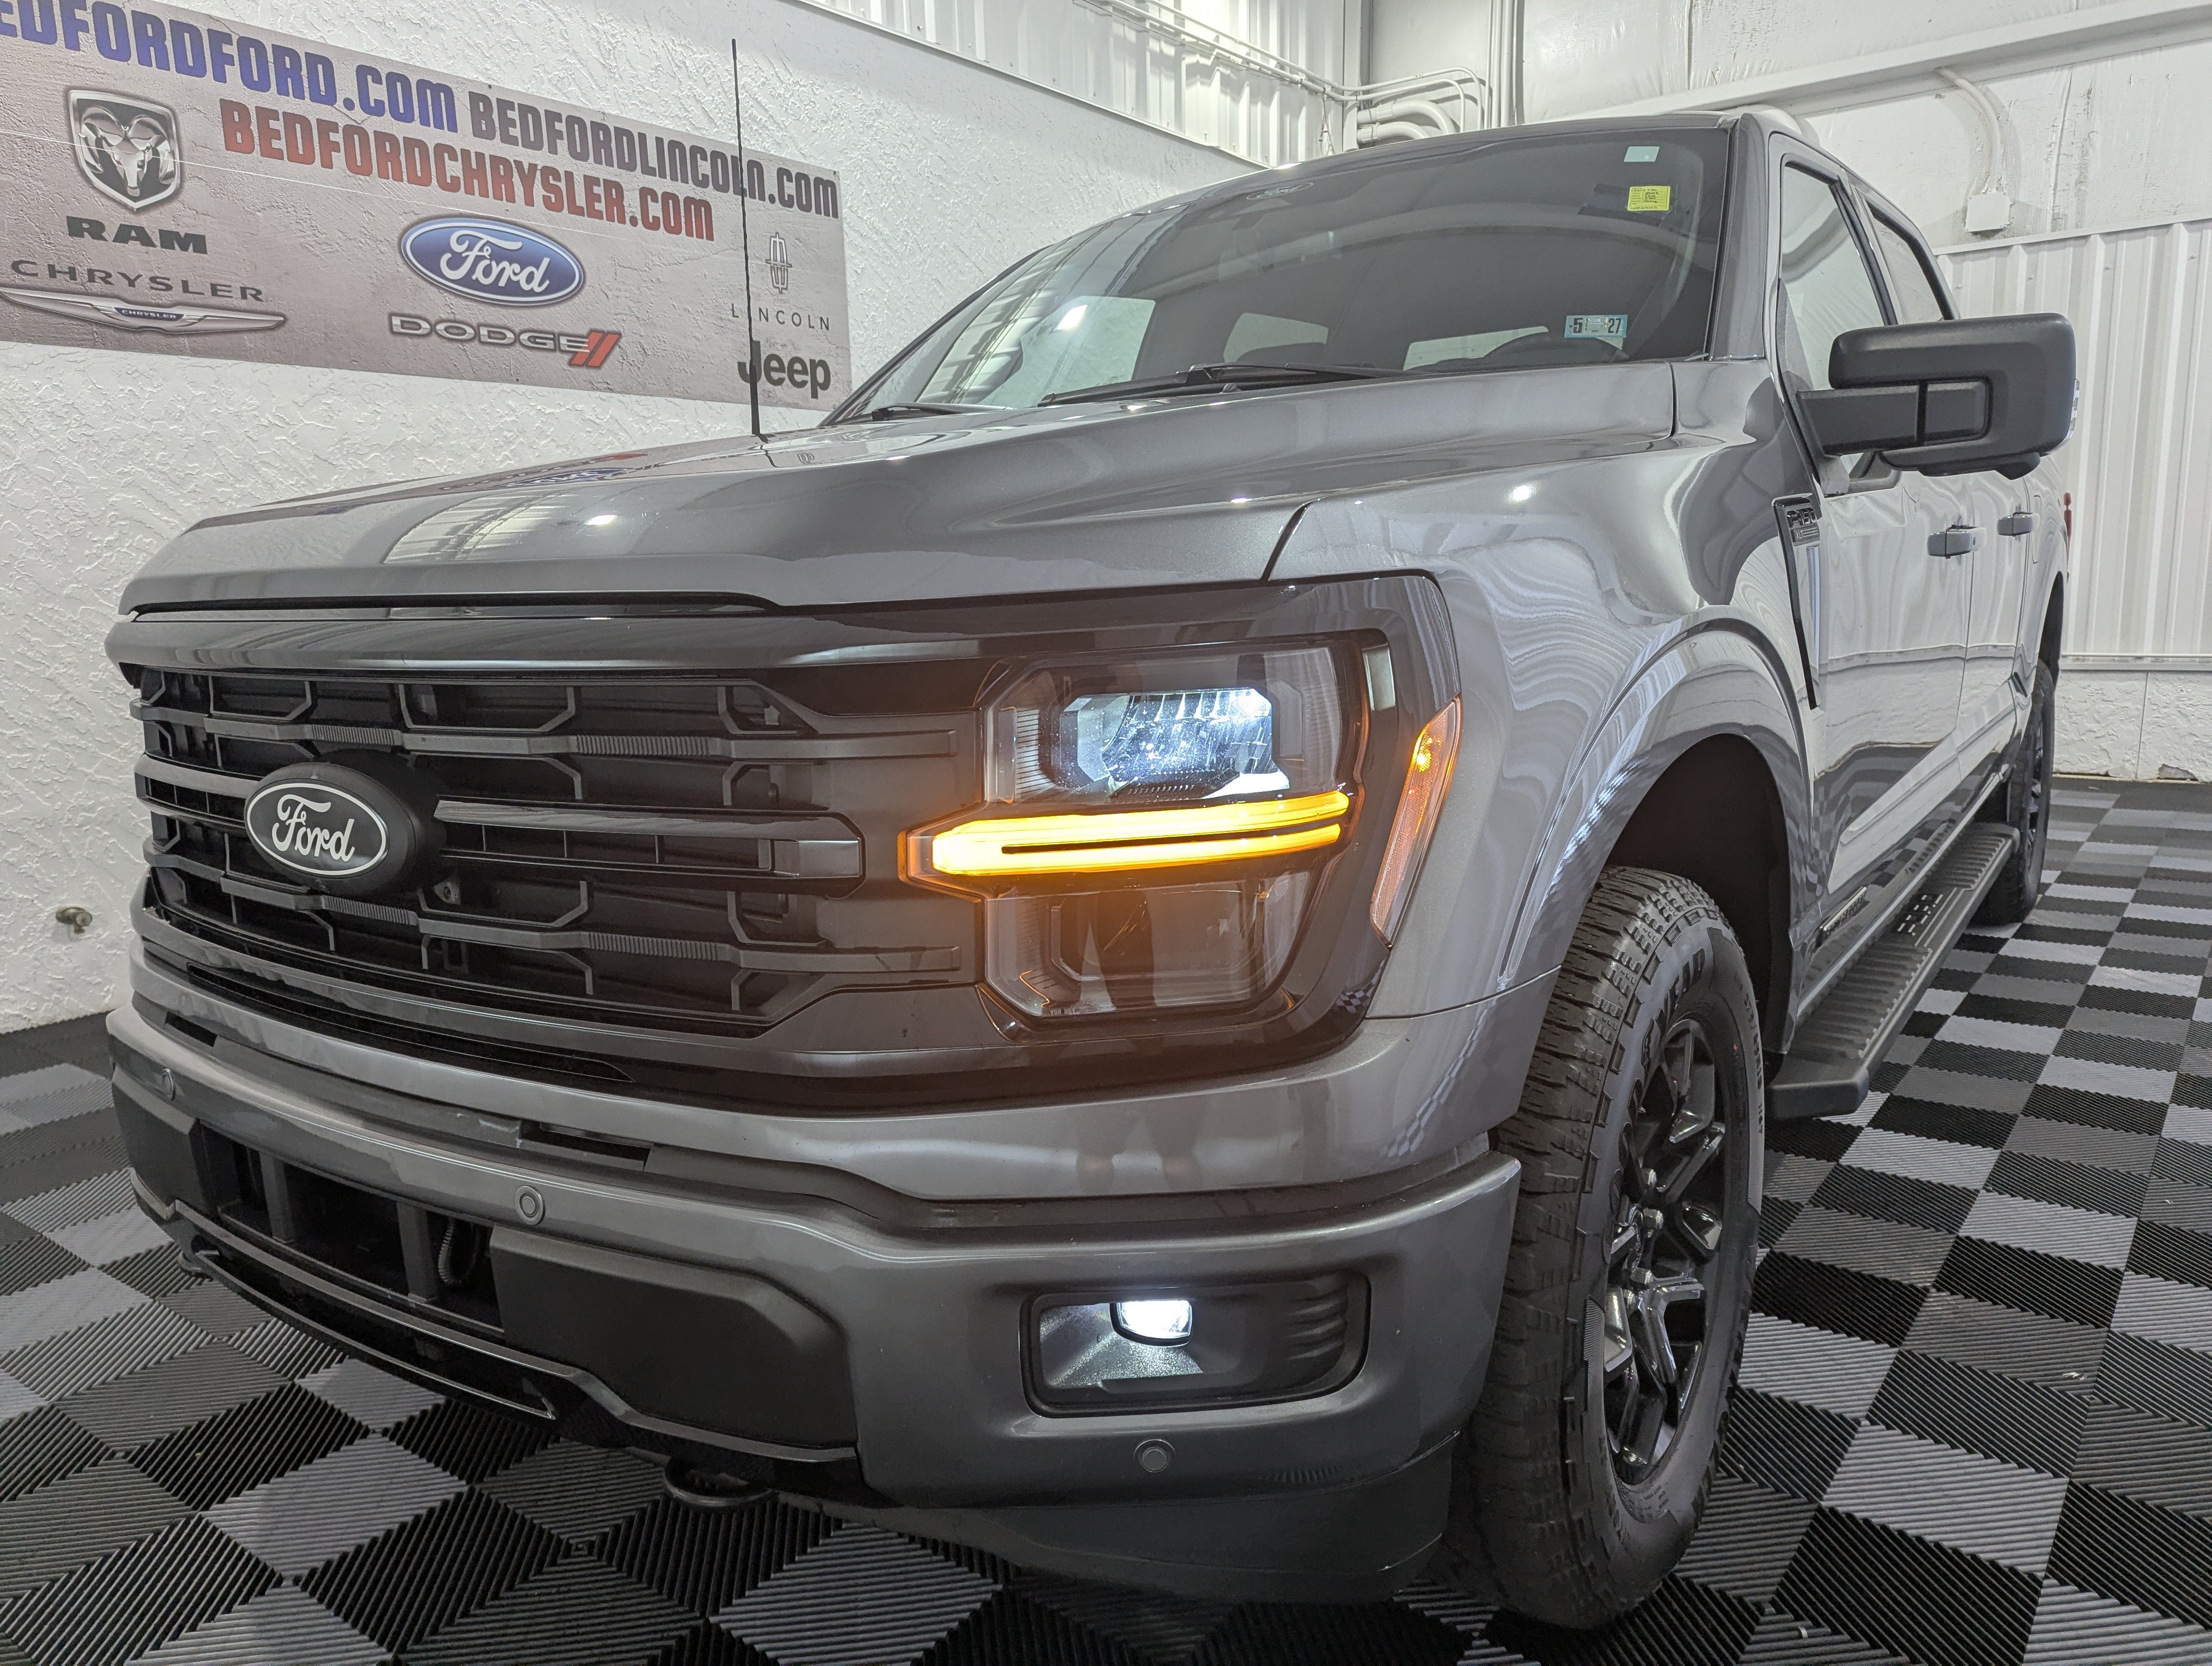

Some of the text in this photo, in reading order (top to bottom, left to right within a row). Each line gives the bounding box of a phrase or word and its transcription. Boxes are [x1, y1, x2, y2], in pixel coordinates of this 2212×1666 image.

[219, 98, 714, 242] BEDFORDCHRYSLER.COM
[469, 92, 839, 219] BEDFORDLINCOLN.COM
[66, 215, 208, 255] RAM
[11, 260, 265, 303] CHRYSLER
[440, 230, 551, 293] Ford
[121, 310, 177, 319] CHRYSLER
[391, 316, 590, 353] DODGE
[731, 303, 829, 331] LNCOLN
[1573, 317, 1583, 333] 5
[1607, 318, 1622, 334] 27
[737, 339, 832, 400] Jeep
[272, 793, 355, 862] Ford
